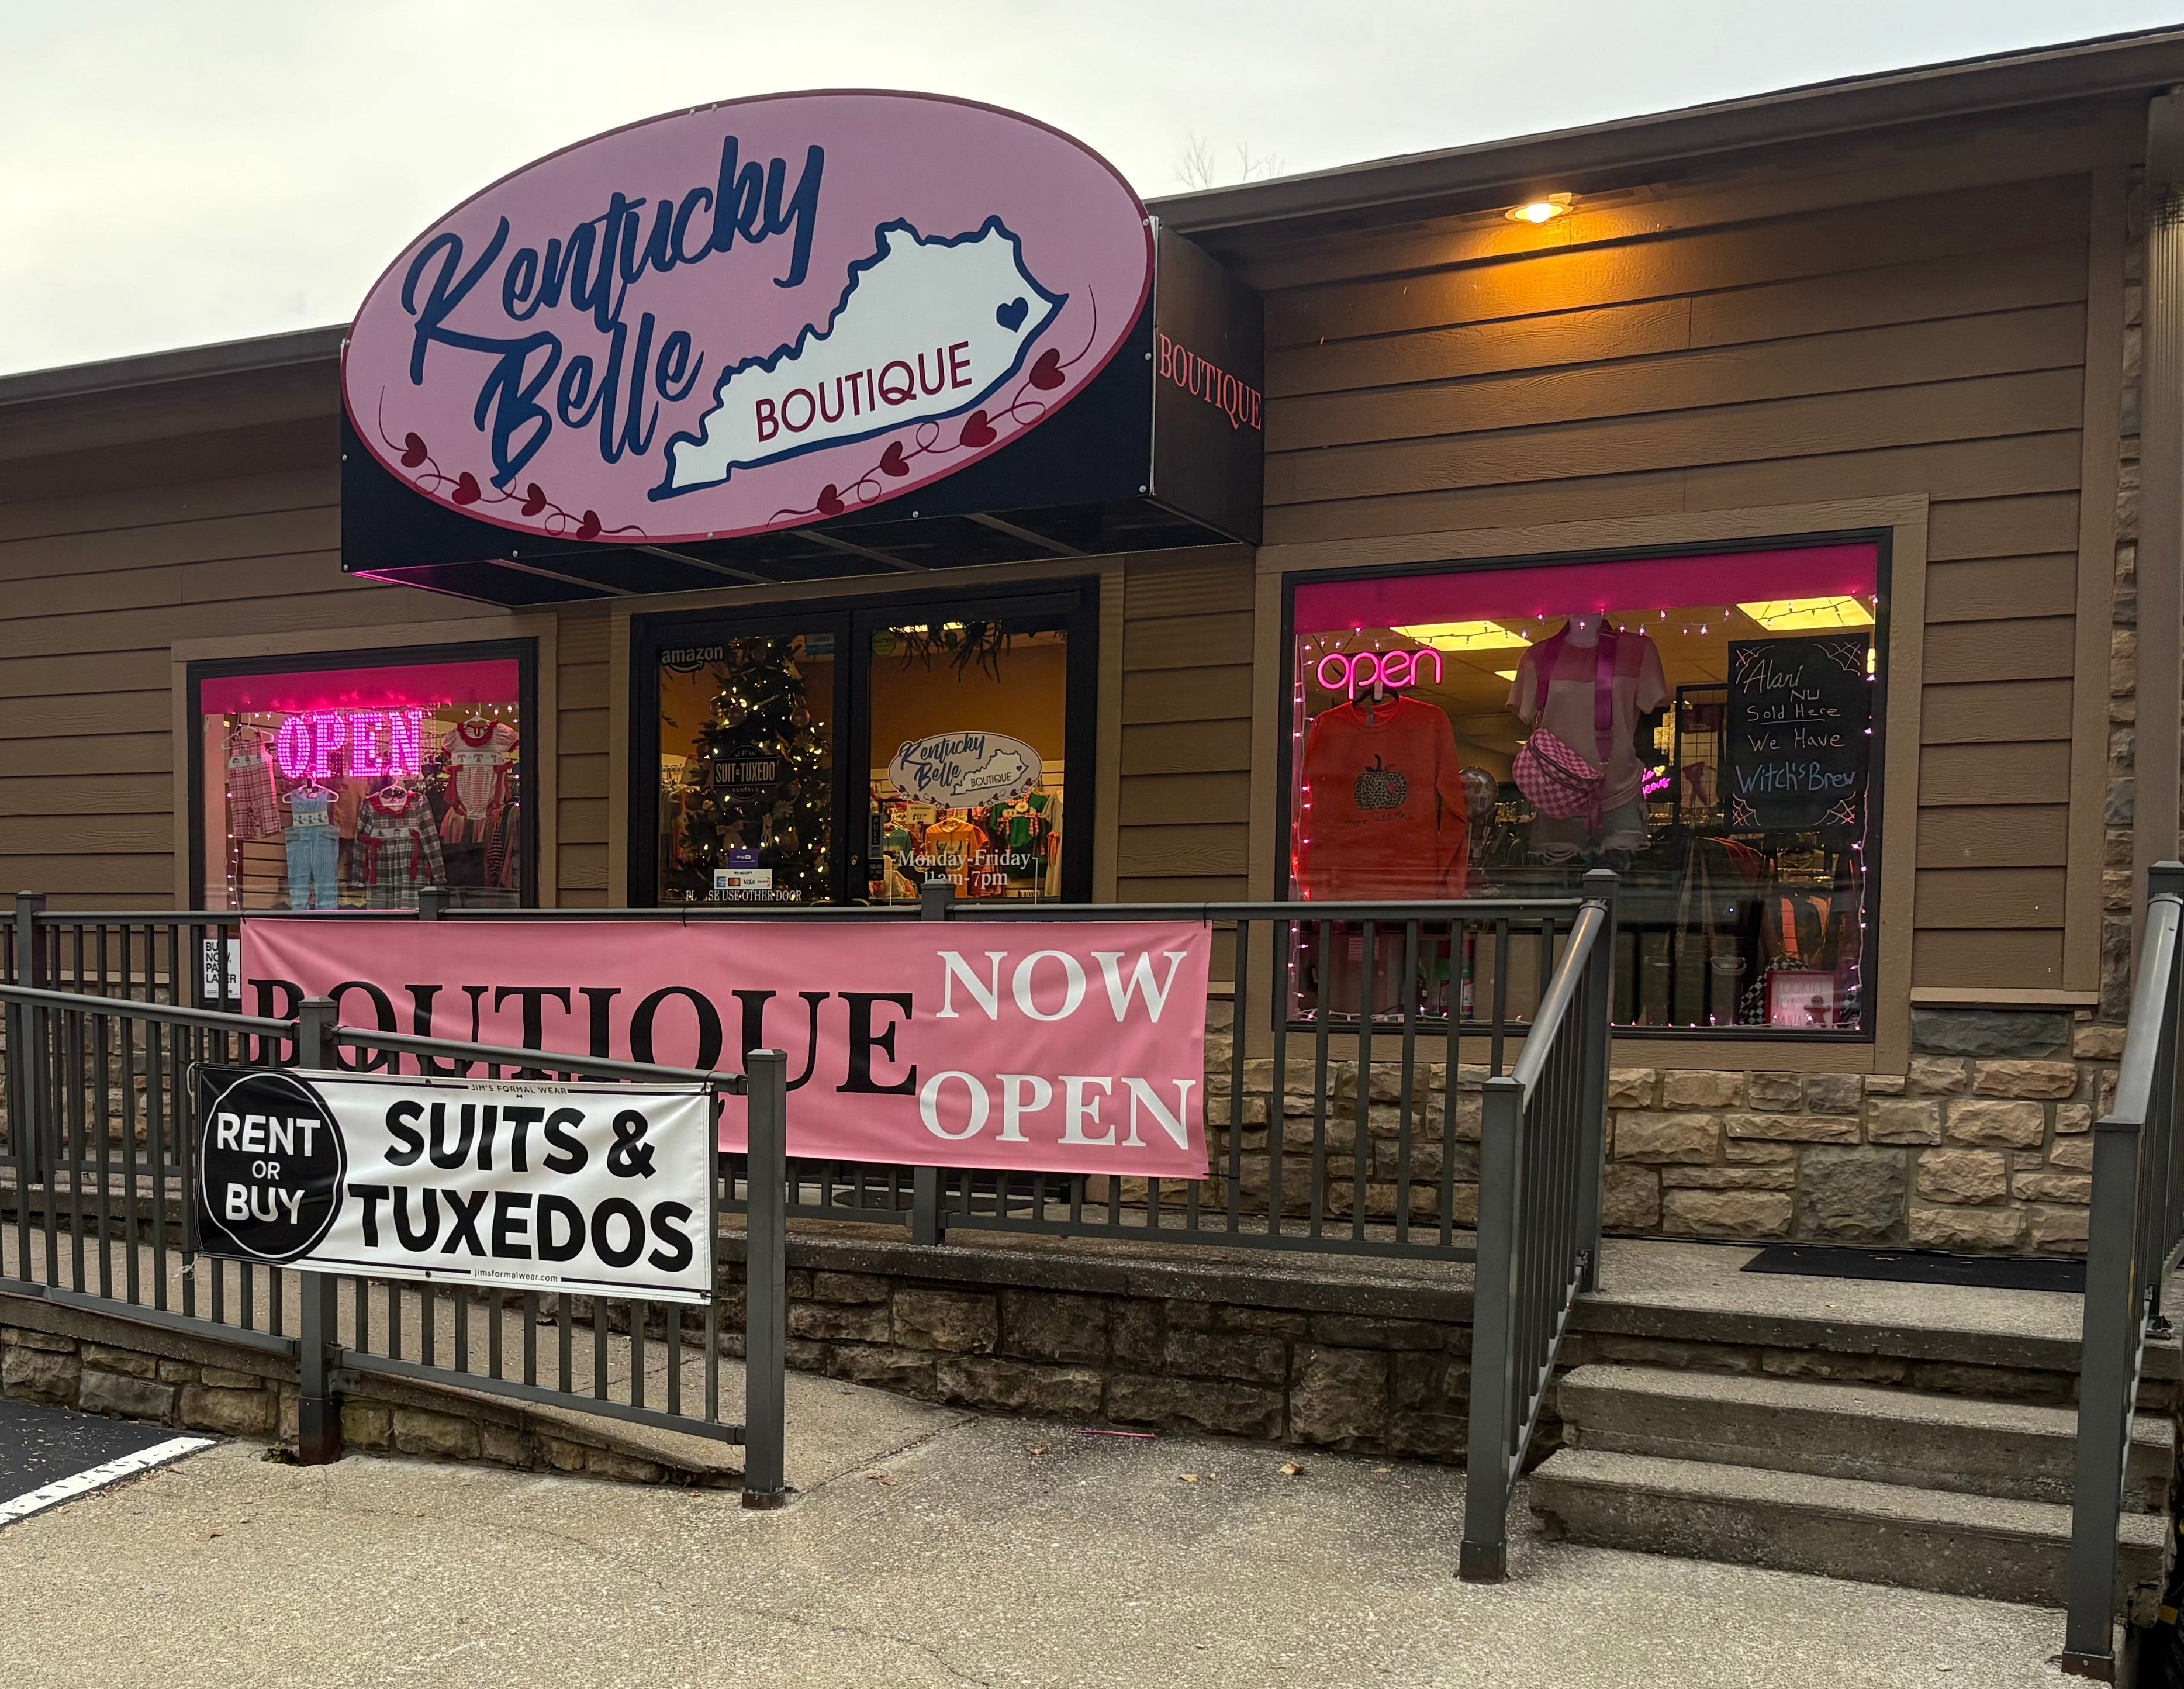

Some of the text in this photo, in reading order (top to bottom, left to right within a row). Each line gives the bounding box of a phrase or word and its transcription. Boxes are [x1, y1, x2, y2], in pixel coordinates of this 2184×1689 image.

[401, 136, 825, 385] Kentucky
[755, 341, 972, 442] BOUTIQUE
[1159, 333, 1262, 430] BOUTIQUE
[474, 312, 704, 489] Belle
[661, 646, 724, 664] amazon
[1317, 650, 1442, 700] open
[1744, 659, 1803, 694] Alani
[1747, 703, 1841, 722] Sold Here
[277, 710, 423, 779] OPEN
[899, 733, 986, 771] Kentucky
[1748, 728, 1845, 752] We Have
[716, 762, 736, 783] SUIT
[740, 761, 776, 782] TUXEDO
[914, 761, 962, 792] Belle
[971, 772, 1011, 787] BOUTIQUE
[1736, 761, 1856, 794] Witch's Brew
[899, 849, 1031, 871] Monday-Friday
[686, 890, 801, 901] PLSE USE OTHER DOOR
[206, 942, 219, 952] BU
[206, 963, 219, 973] PA
[936, 949, 1187, 1023] NOW
[248, 979, 917, 1120] BOUTIQUE
[497, 1085, 535, 1093] FORMAL
[920, 1071, 1197, 1150] OPEN
[217, 1112, 321, 1157] RENT
[383, 1100, 656, 1179] SUITS &
[251, 1160, 281, 1180] OR
[226, 1183, 305, 1225] BUY
[347, 1183, 693, 1273] TUXEDOS
[474, 1269, 558, 1282] jimsformalwear.com
